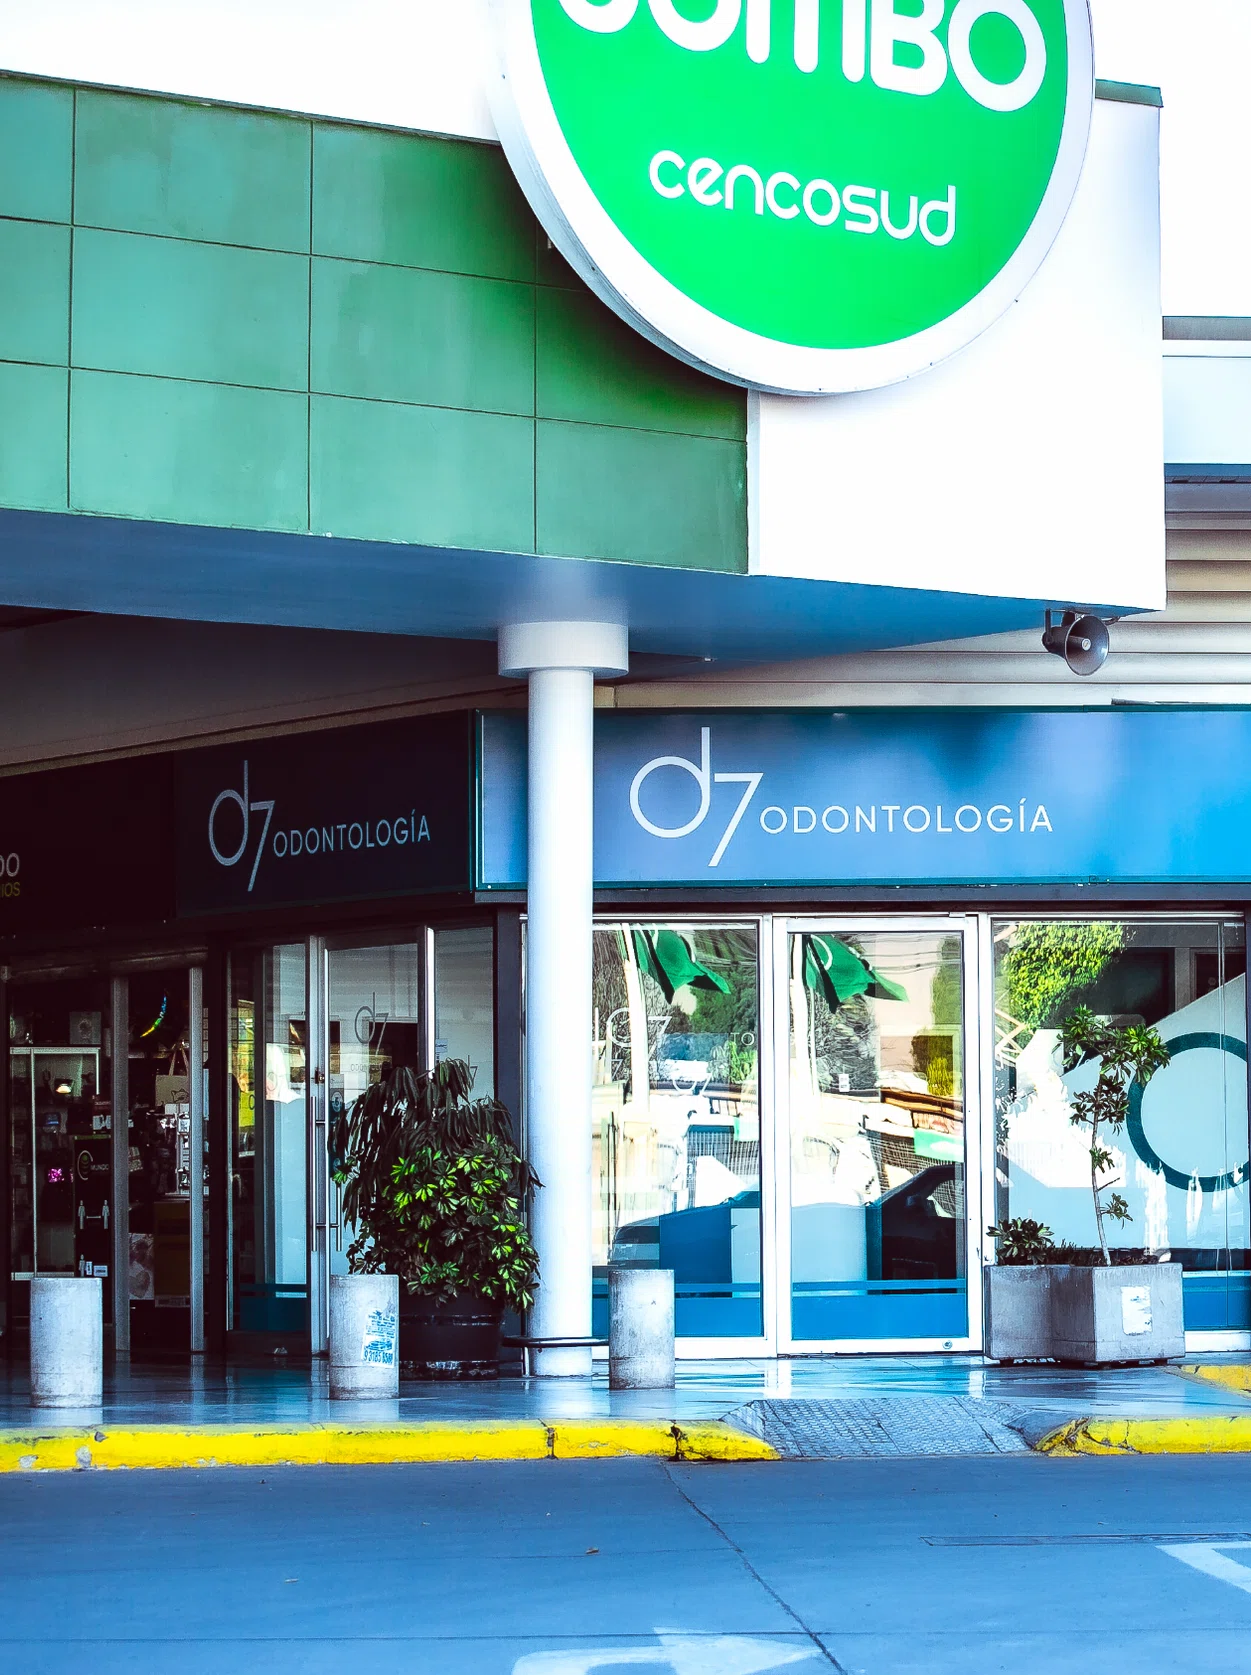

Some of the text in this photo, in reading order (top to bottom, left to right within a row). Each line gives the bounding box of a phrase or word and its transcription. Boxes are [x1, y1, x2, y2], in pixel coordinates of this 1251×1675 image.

[649, 149, 956, 247] cencosud
[273, 809, 431, 857] ODONTOLOGÍA
[629, 726, 1053, 867] d7 ODONTOLOGÍA
